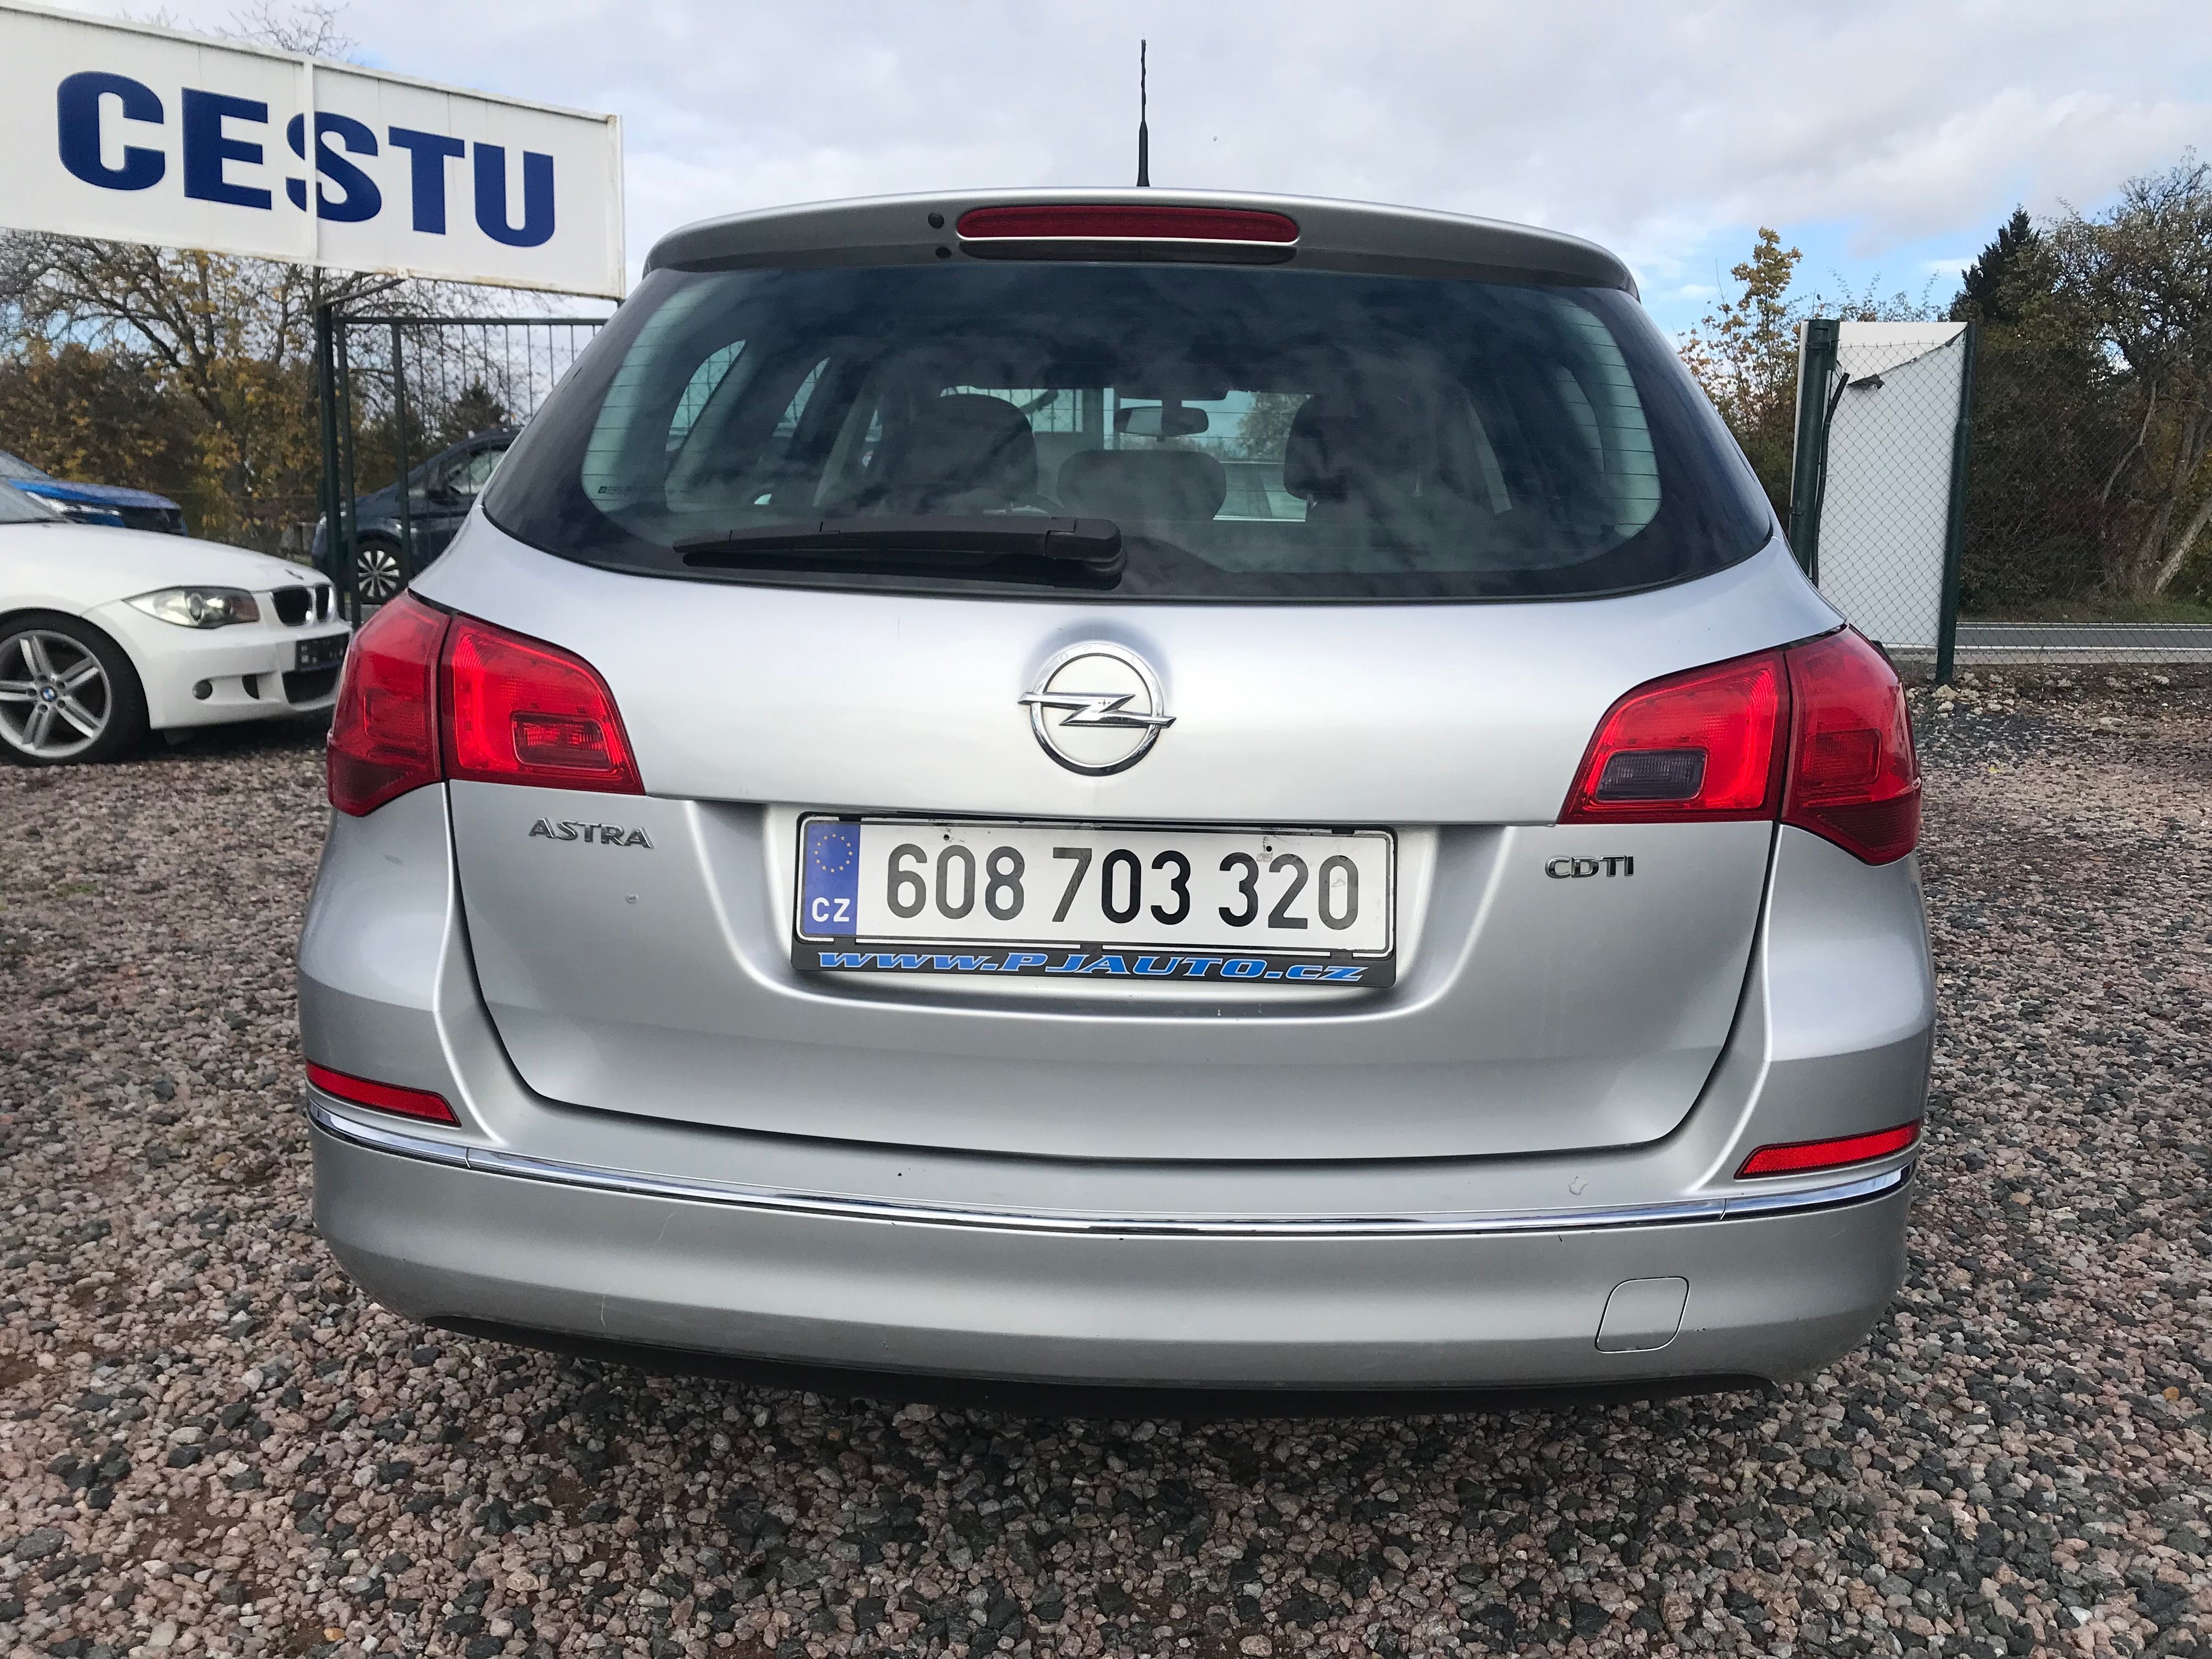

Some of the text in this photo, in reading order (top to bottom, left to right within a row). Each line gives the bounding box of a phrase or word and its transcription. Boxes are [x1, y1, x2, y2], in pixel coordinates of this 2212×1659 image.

[56, 70, 556, 248] CESTU
[1057, 644, 1137, 665] OPL
[528, 816, 654, 849] ASTRA
[1544, 855, 1634, 879] CDTI
[887, 843, 1359, 930] 608 703 320
[811, 897, 850, 923] CZ
